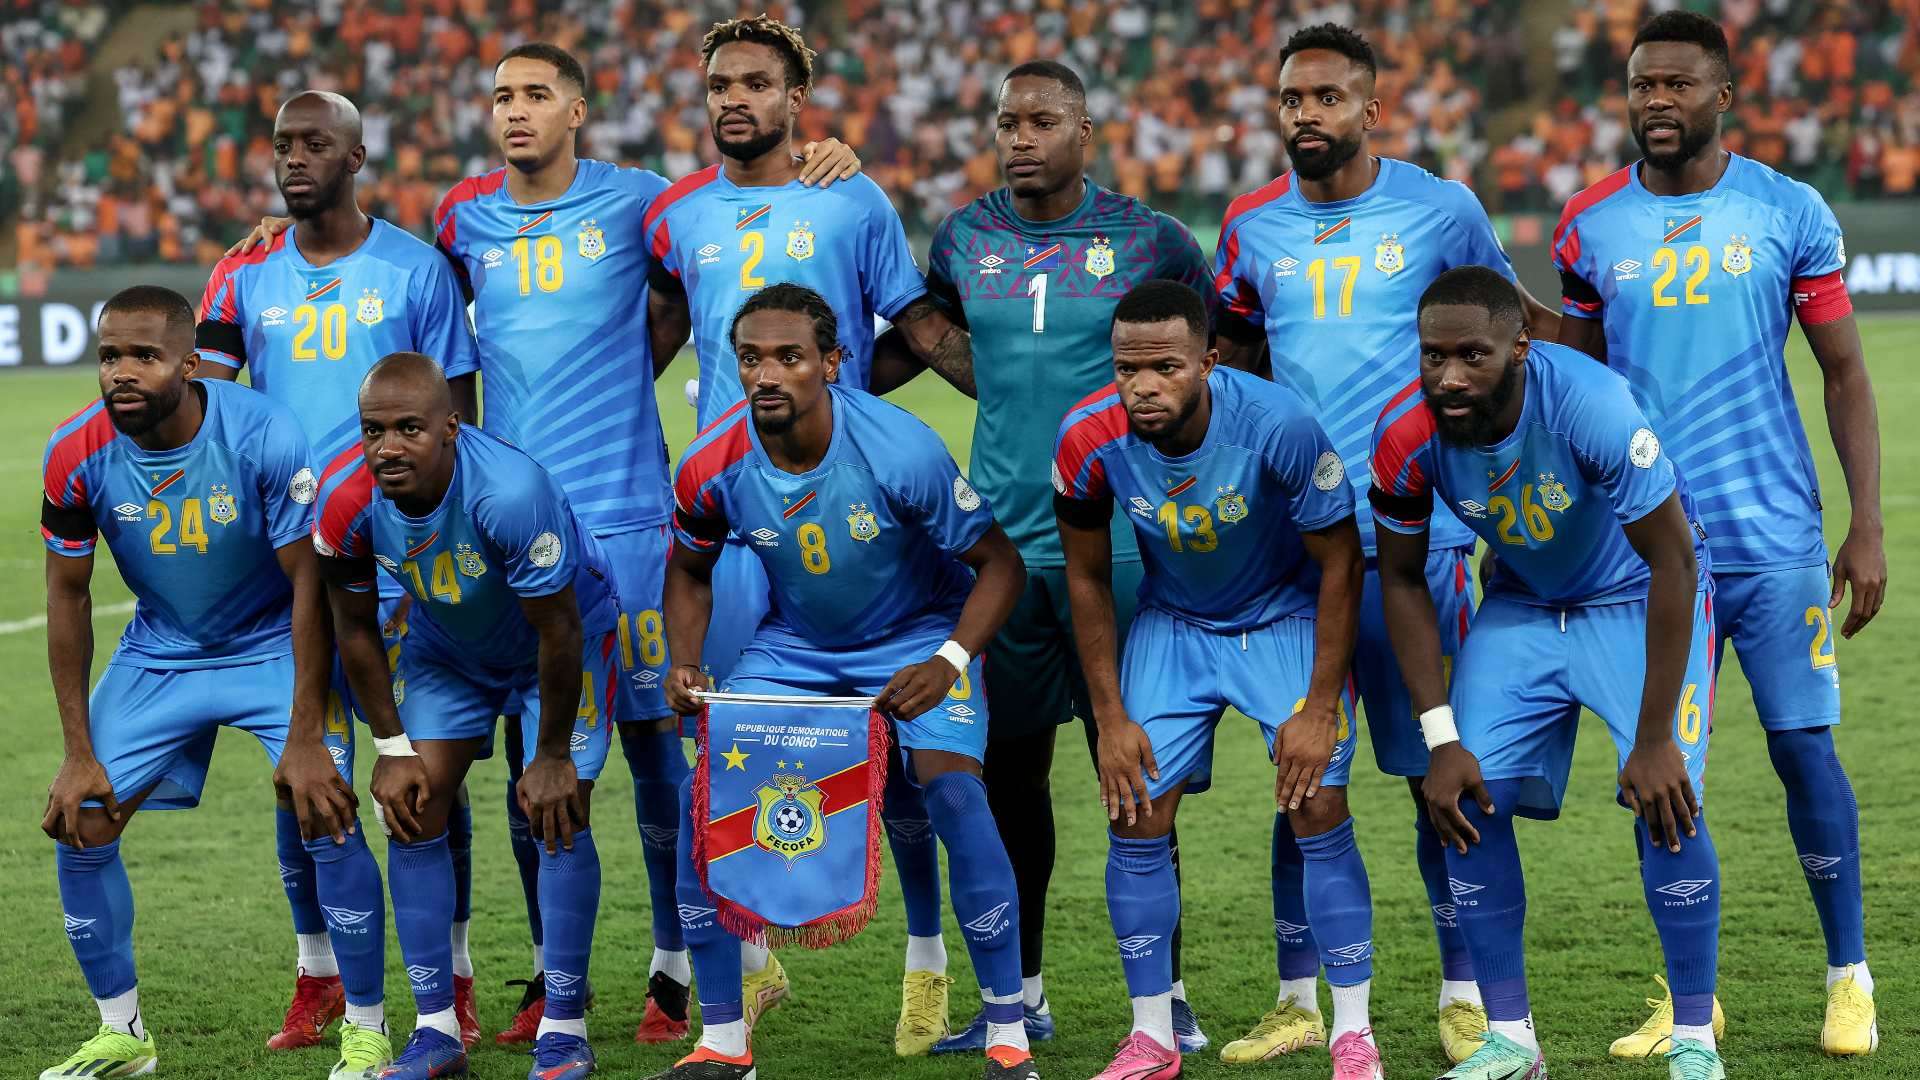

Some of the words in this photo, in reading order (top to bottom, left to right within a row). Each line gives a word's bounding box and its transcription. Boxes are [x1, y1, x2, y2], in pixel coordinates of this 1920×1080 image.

[511, 235, 563, 296] 18
[740, 231, 765, 290] 2
[1306, 256, 1360, 319] 17
[1651, 245, 1710, 307] 22
[1028, 274, 1048, 332] 1
[292, 304, 347, 361] 20
[146, 499, 208, 555] 24
[1131, 507, 1153, 519] umbro
[1157, 502, 1217, 552] 13
[1488, 484, 1554, 545] 26
[797, 522, 831, 575] 8
[402, 550, 462, 604] 14
[617, 609, 666, 671] 18
[1805, 606, 1836, 669] 2
[326, 690, 350, 745] 4
[577, 671, 598, 729] 4
[950, 716, 974, 725] umbro
[1677, 683, 1702, 745] 6
[735, 723, 786, 734] REPUBLIQUE
[787, 726, 849, 737] DEMOCRATIQUE
[764, 735, 780, 746] DU
[782, 736, 818, 748] CONGO
[766, 834, 815, 851] FECOFA
[680, 919, 713, 930] mbro
[1665, 894, 1709, 906] umbro
[973, 919, 1009, 941] umbro
